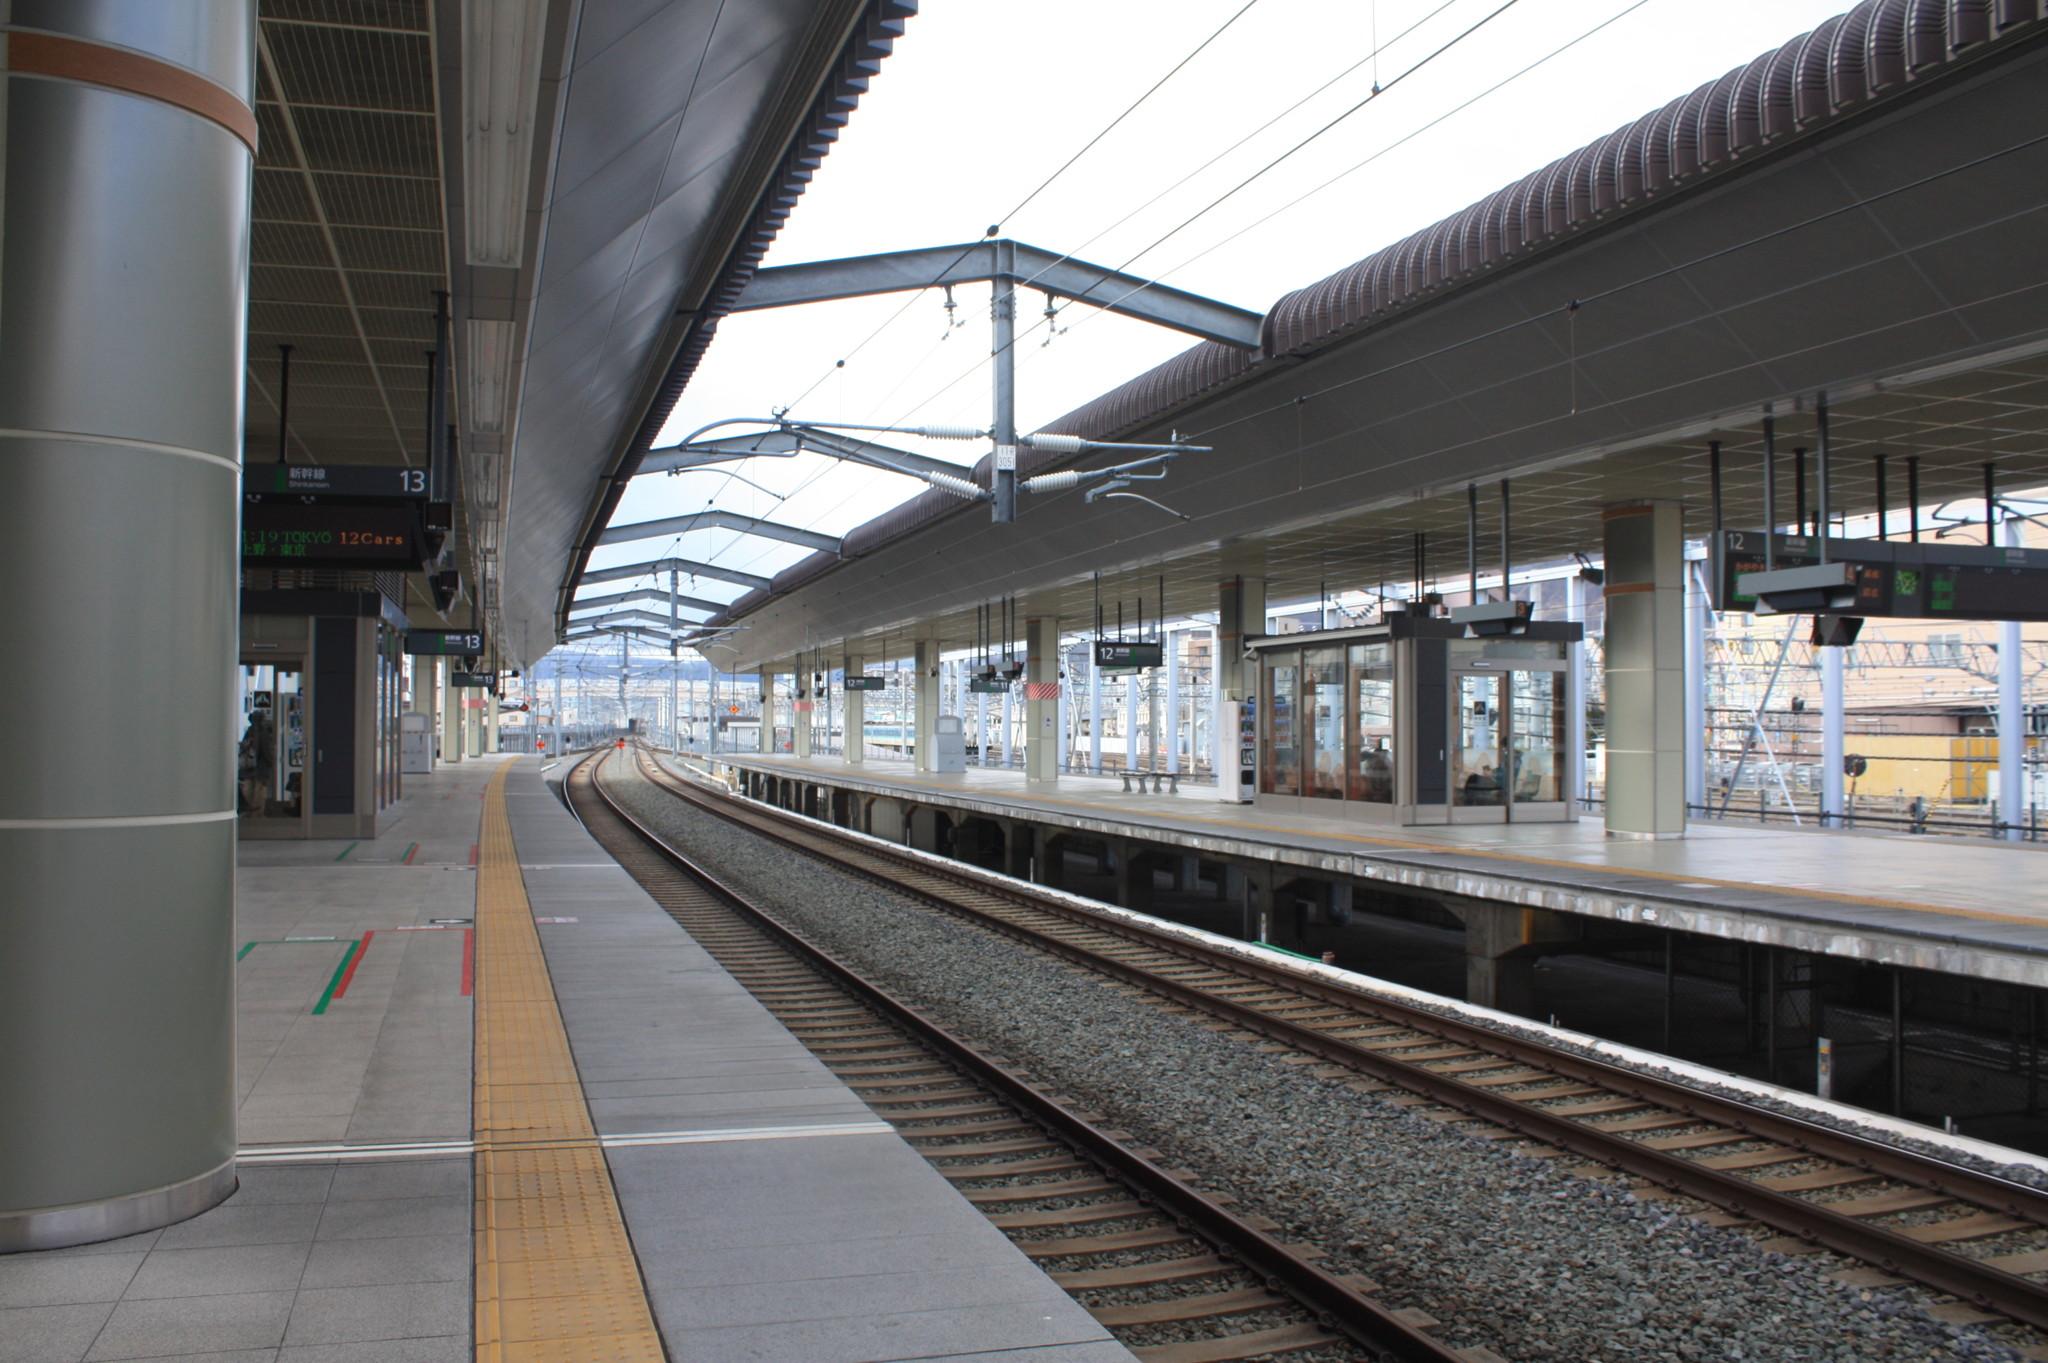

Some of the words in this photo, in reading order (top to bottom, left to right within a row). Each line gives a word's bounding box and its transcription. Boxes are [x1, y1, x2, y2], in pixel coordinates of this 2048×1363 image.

[289, 467, 326, 480] 新幹線
[400, 470, 426, 492] 13
[280, 531, 332, 544] TOKYO
[339, 531, 404, 545] 12Cars
[1728, 533, 1744, 550] 12
[465, 635, 480, 649] 13
[1100, 648, 1113, 659] 12
[485, 676, 494, 684] 13
[847, 679, 856, 687] 12
